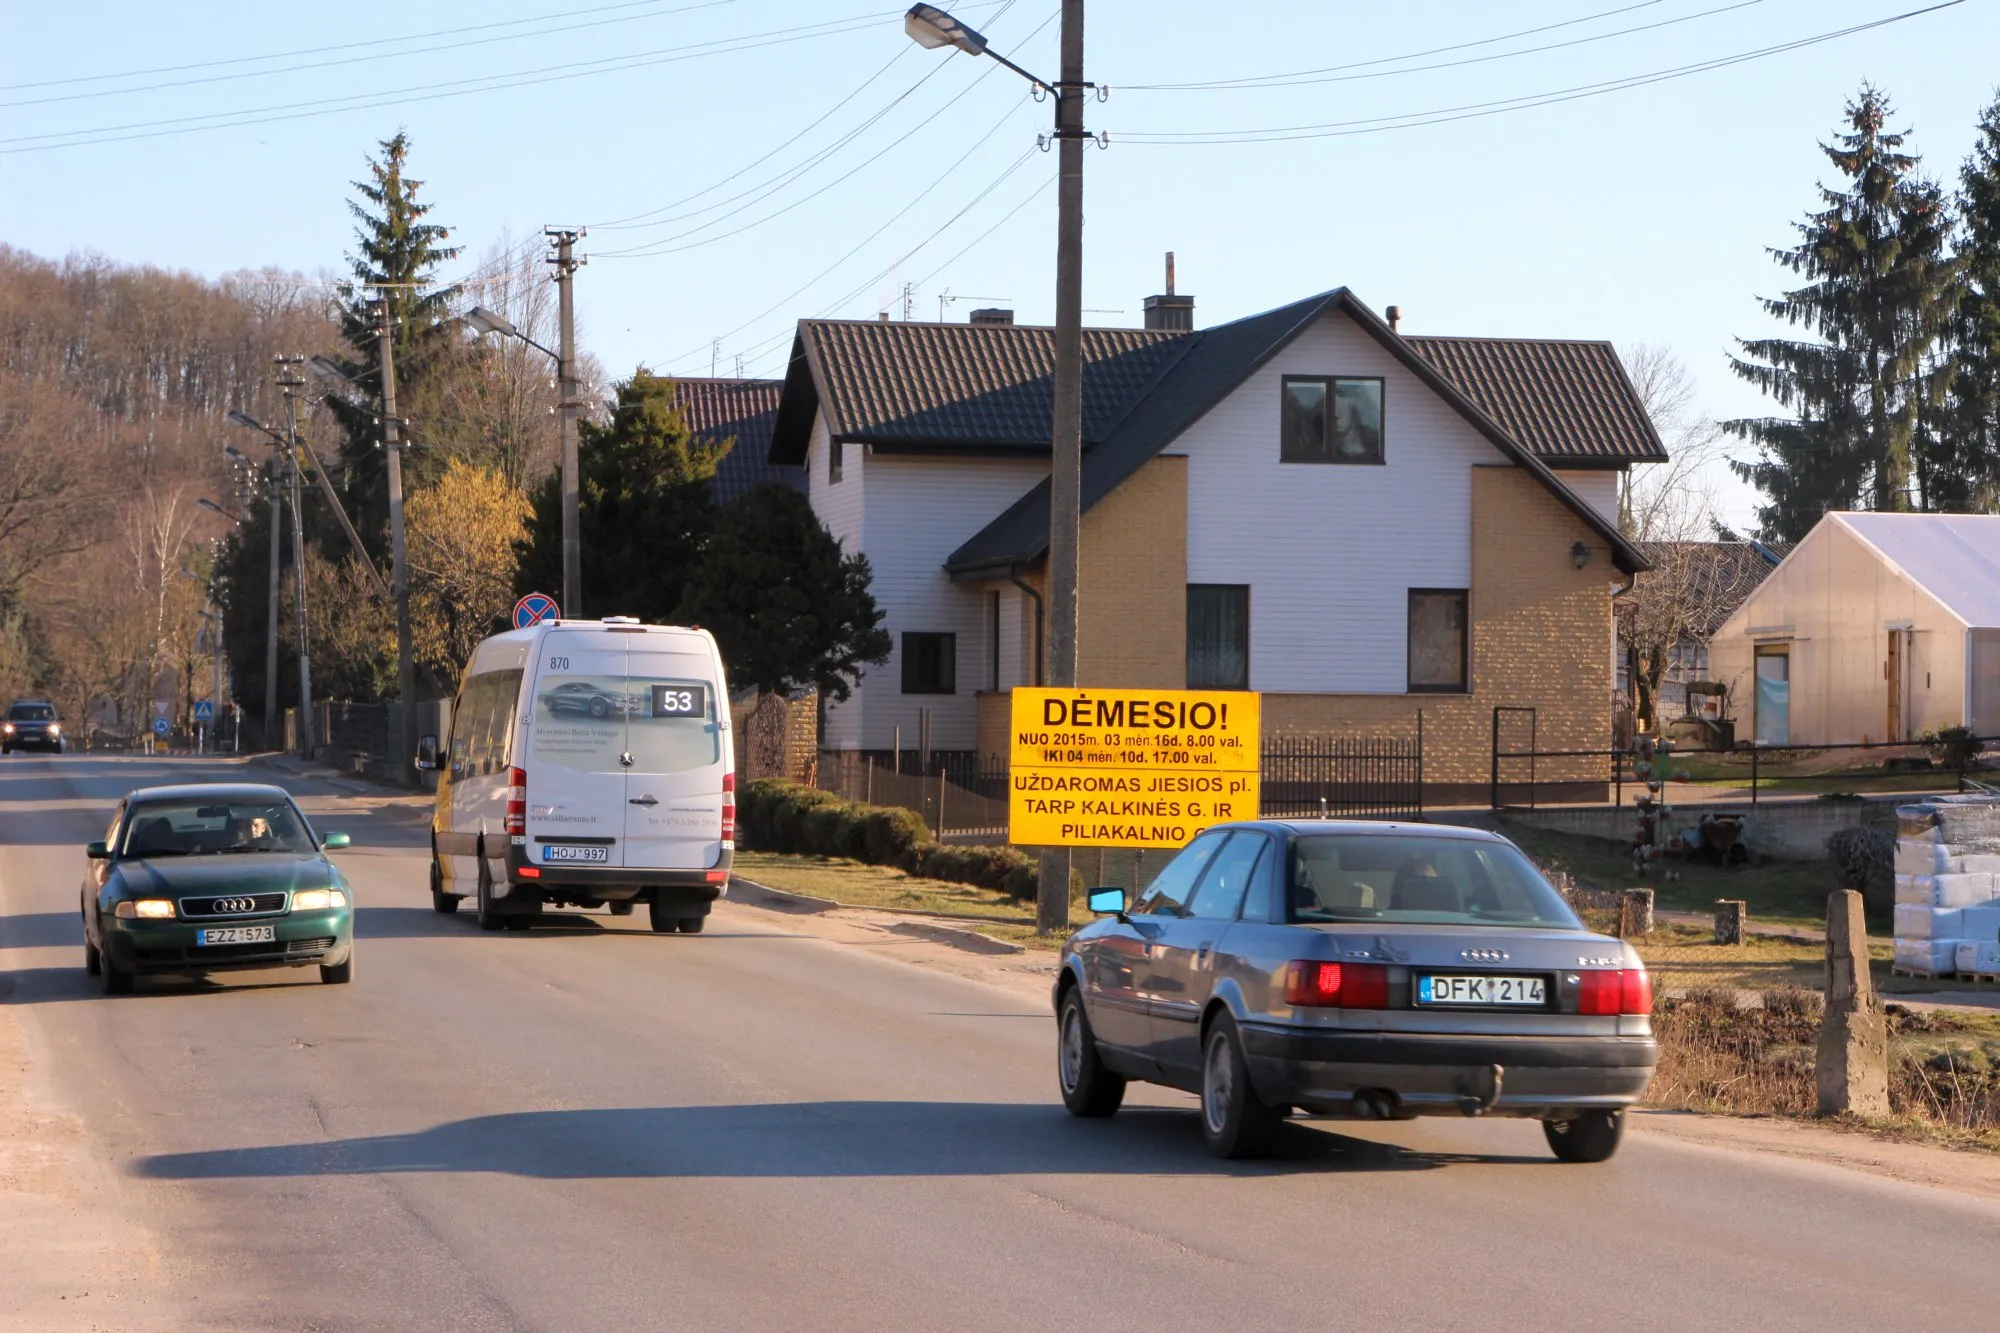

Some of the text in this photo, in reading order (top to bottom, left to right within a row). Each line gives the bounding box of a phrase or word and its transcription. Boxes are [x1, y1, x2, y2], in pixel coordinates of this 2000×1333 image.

[550, 656, 569, 670] 870
[664, 690, 692, 711] 53
[1043, 693, 1228, 730] DĖMESIO!
[1018, 733, 1049, 746] NUO
[1053, 733, 1100, 746] 2015m.
[1104, 733, 1121, 746] 03
[1187, 735, 1215, 747] 8.00
[1220, 736, 1243, 747] val.
[1044, 749, 1217, 764] IKI 04 mėn. 10d. 17.00 val.
[1015, 772, 1251, 795] UŽDAROMAS JIESIOS pl.
[1024, 797, 1232, 817] TARP KALKINĖS G. IR
[1062, 824, 1186, 841] PILIAKALNIO
[552, 847, 605, 859] HOJ 997
[206, 927, 272, 943] EZZ 573
[1433, 978, 1543, 1001] DFK 214
